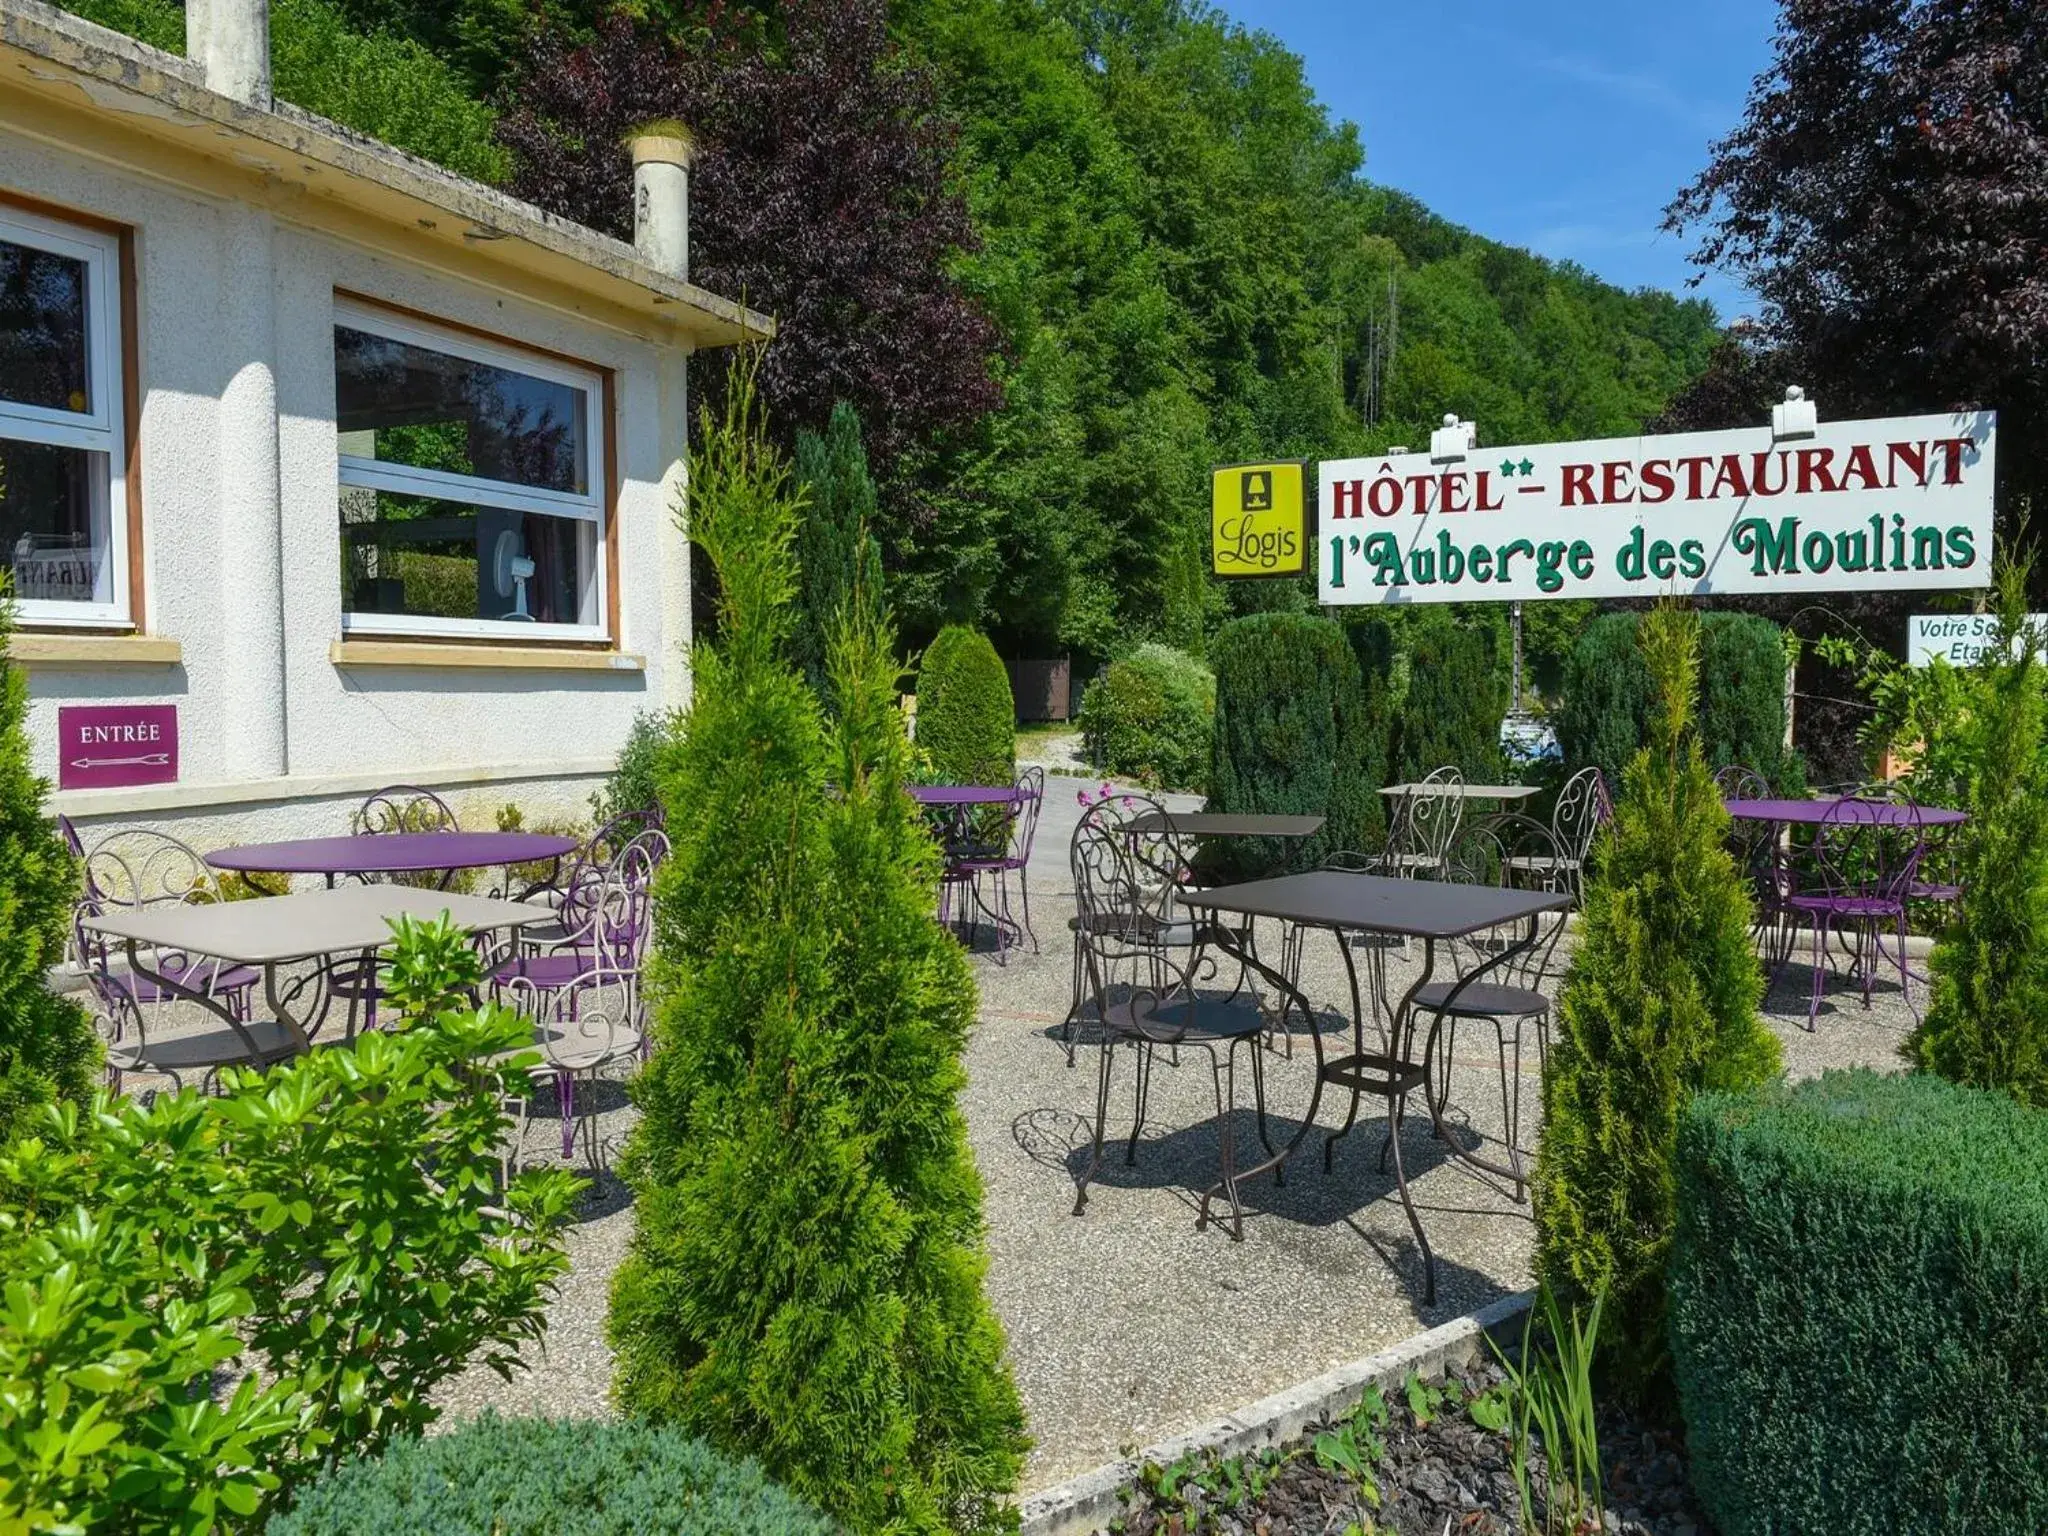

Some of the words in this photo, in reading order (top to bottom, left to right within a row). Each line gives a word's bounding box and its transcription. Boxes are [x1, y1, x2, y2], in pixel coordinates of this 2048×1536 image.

[1332, 462, 1504, 519] HÔTEL
[1560, 438, 1976, 506] RESTAURANT
[1217, 513, 1296, 568] Logis
[1330, 529, 1594, 592] l'Auberge
[1616, 525, 1706, 581] des
[1732, 513, 1977, 576] Moulins
[1919, 619, 1967, 638] Votre
[81, 721, 160, 744] ENTRÉE
